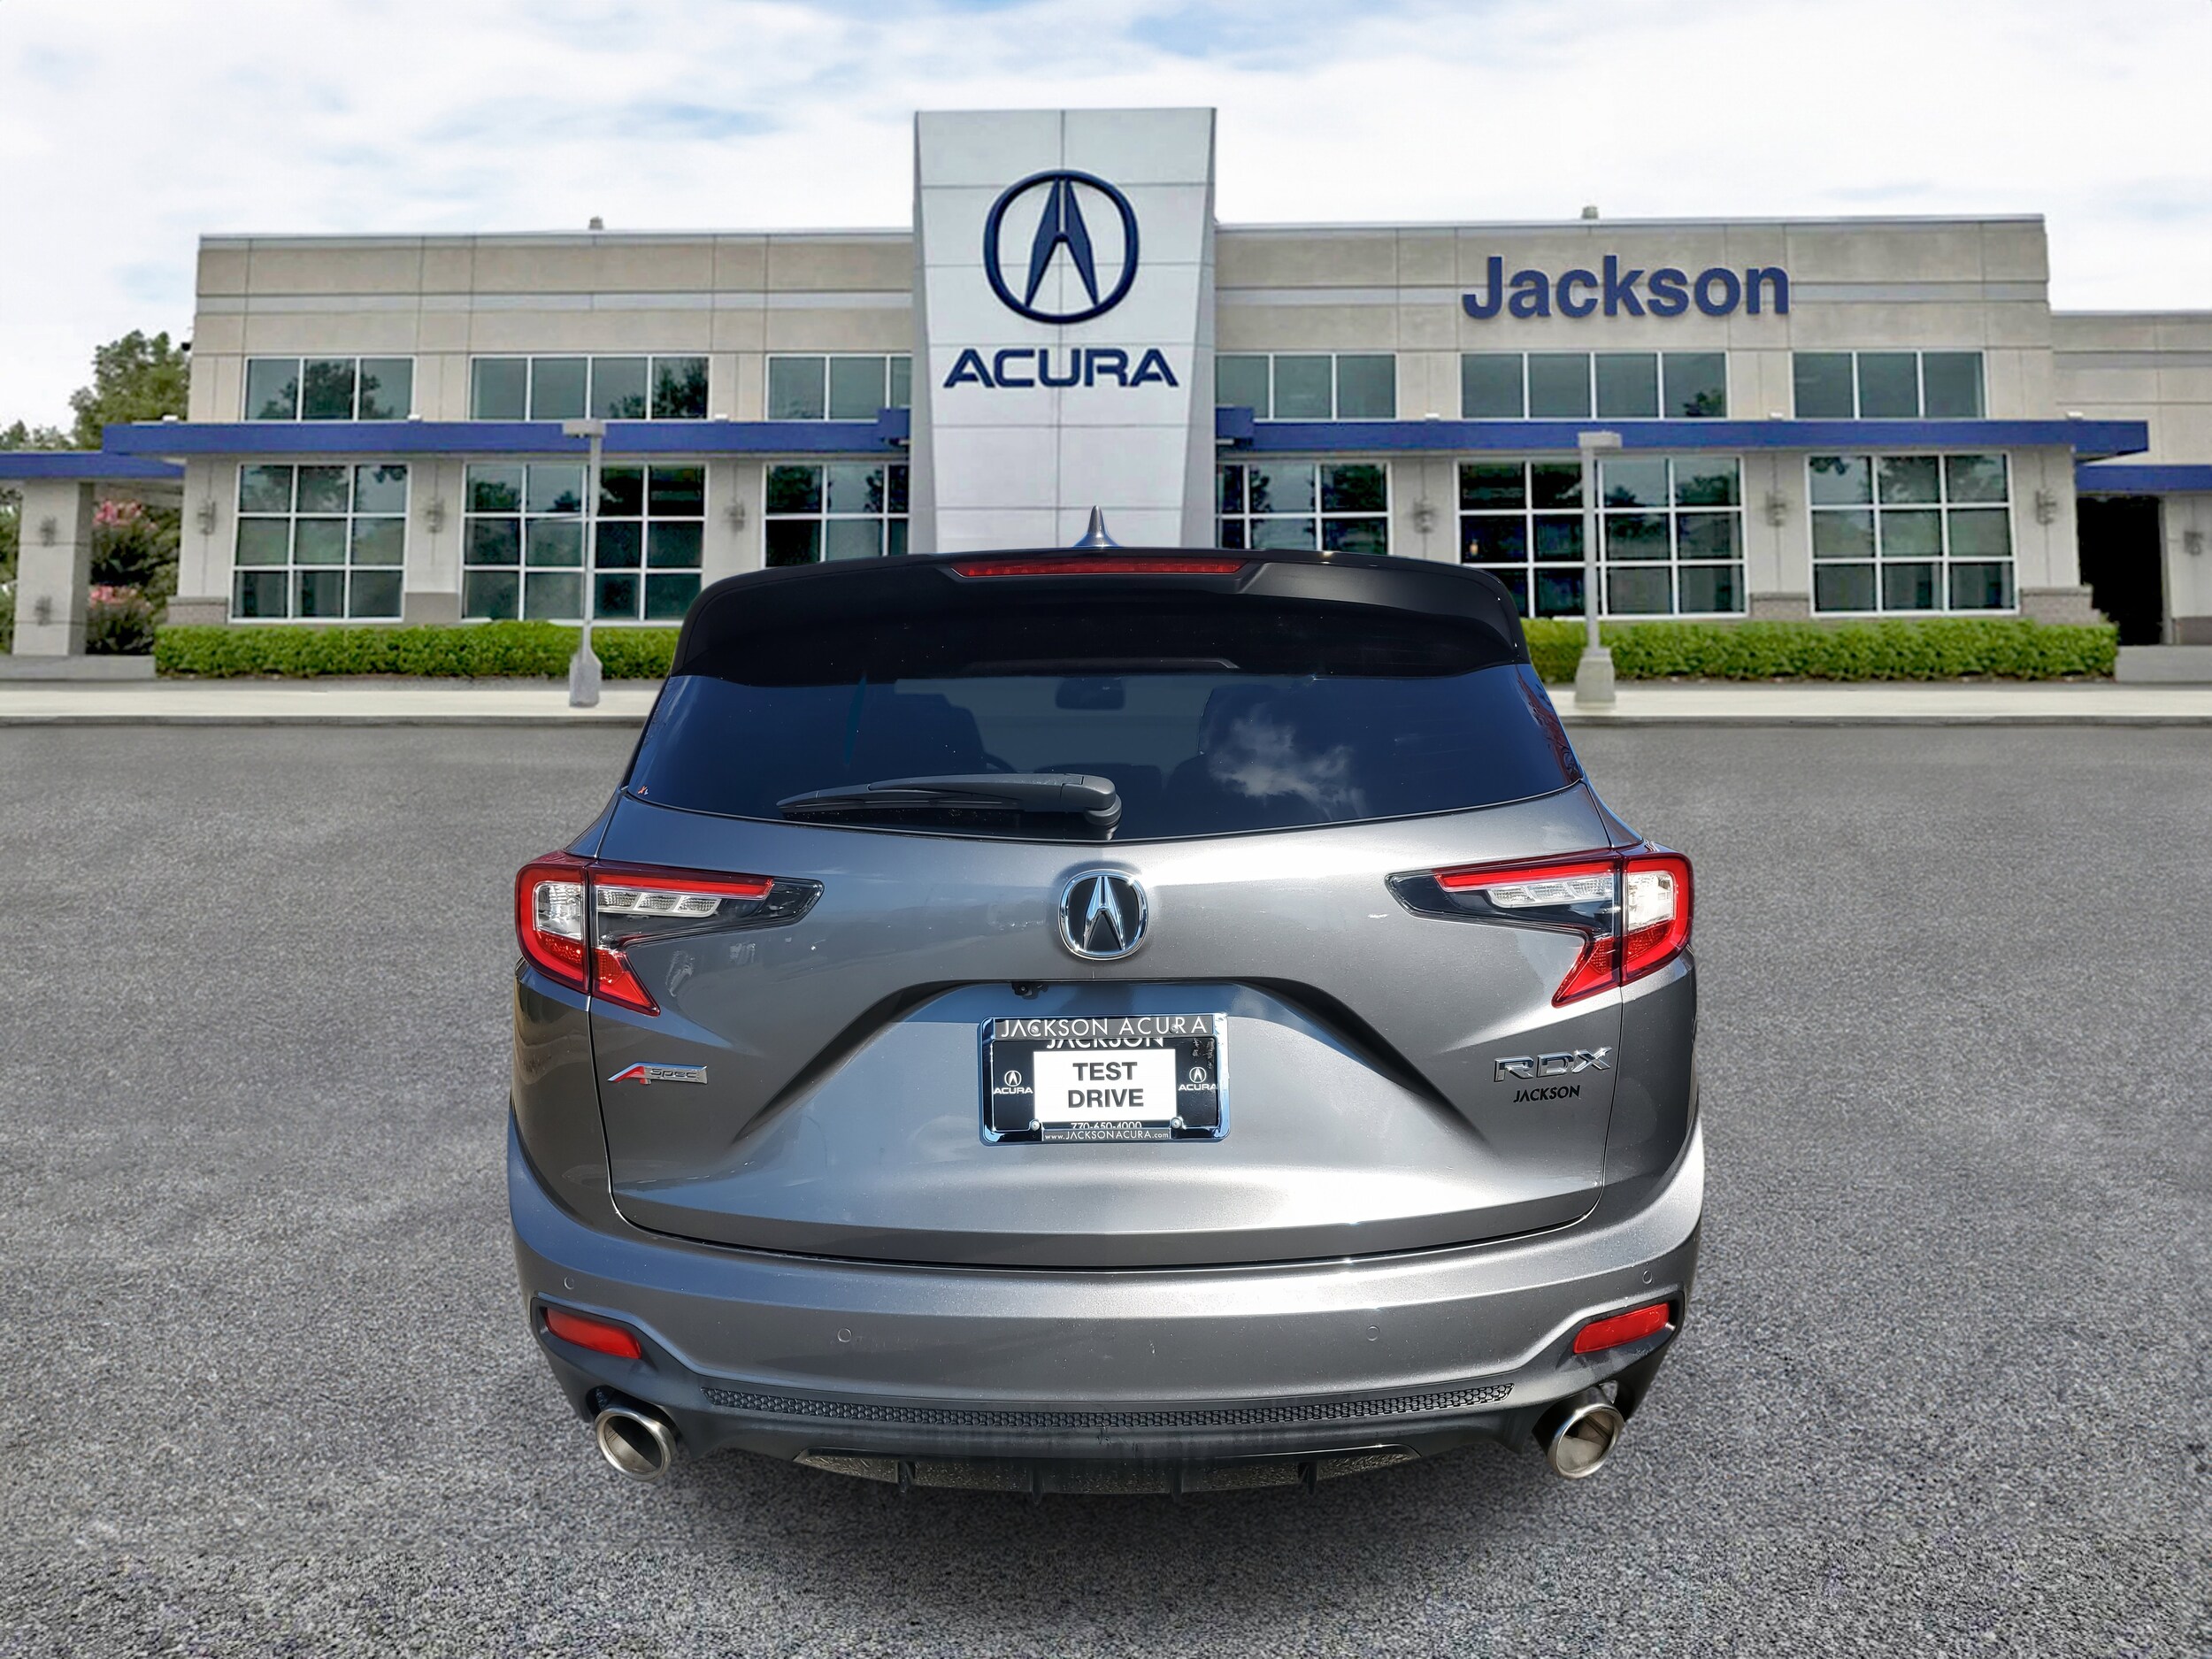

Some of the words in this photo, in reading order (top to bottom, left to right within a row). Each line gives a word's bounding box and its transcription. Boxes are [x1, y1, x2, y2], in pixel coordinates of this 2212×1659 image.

[1462, 255, 1789, 319] Jackson
[942, 348, 1179, 388] ACURA
[1002, 1018, 1108, 1038] JACKSON
[1118, 1016, 1207, 1035] ACURA
[1072, 1061, 1137, 1081] TEST
[1494, 1046, 1612, 1082] RDX
[1068, 1088, 1144, 1108] DRIVE
[1513, 1085, 1580, 1102] JACKSON
[1044, 1130, 1169, 1140] www.JACKSONACURA.com
